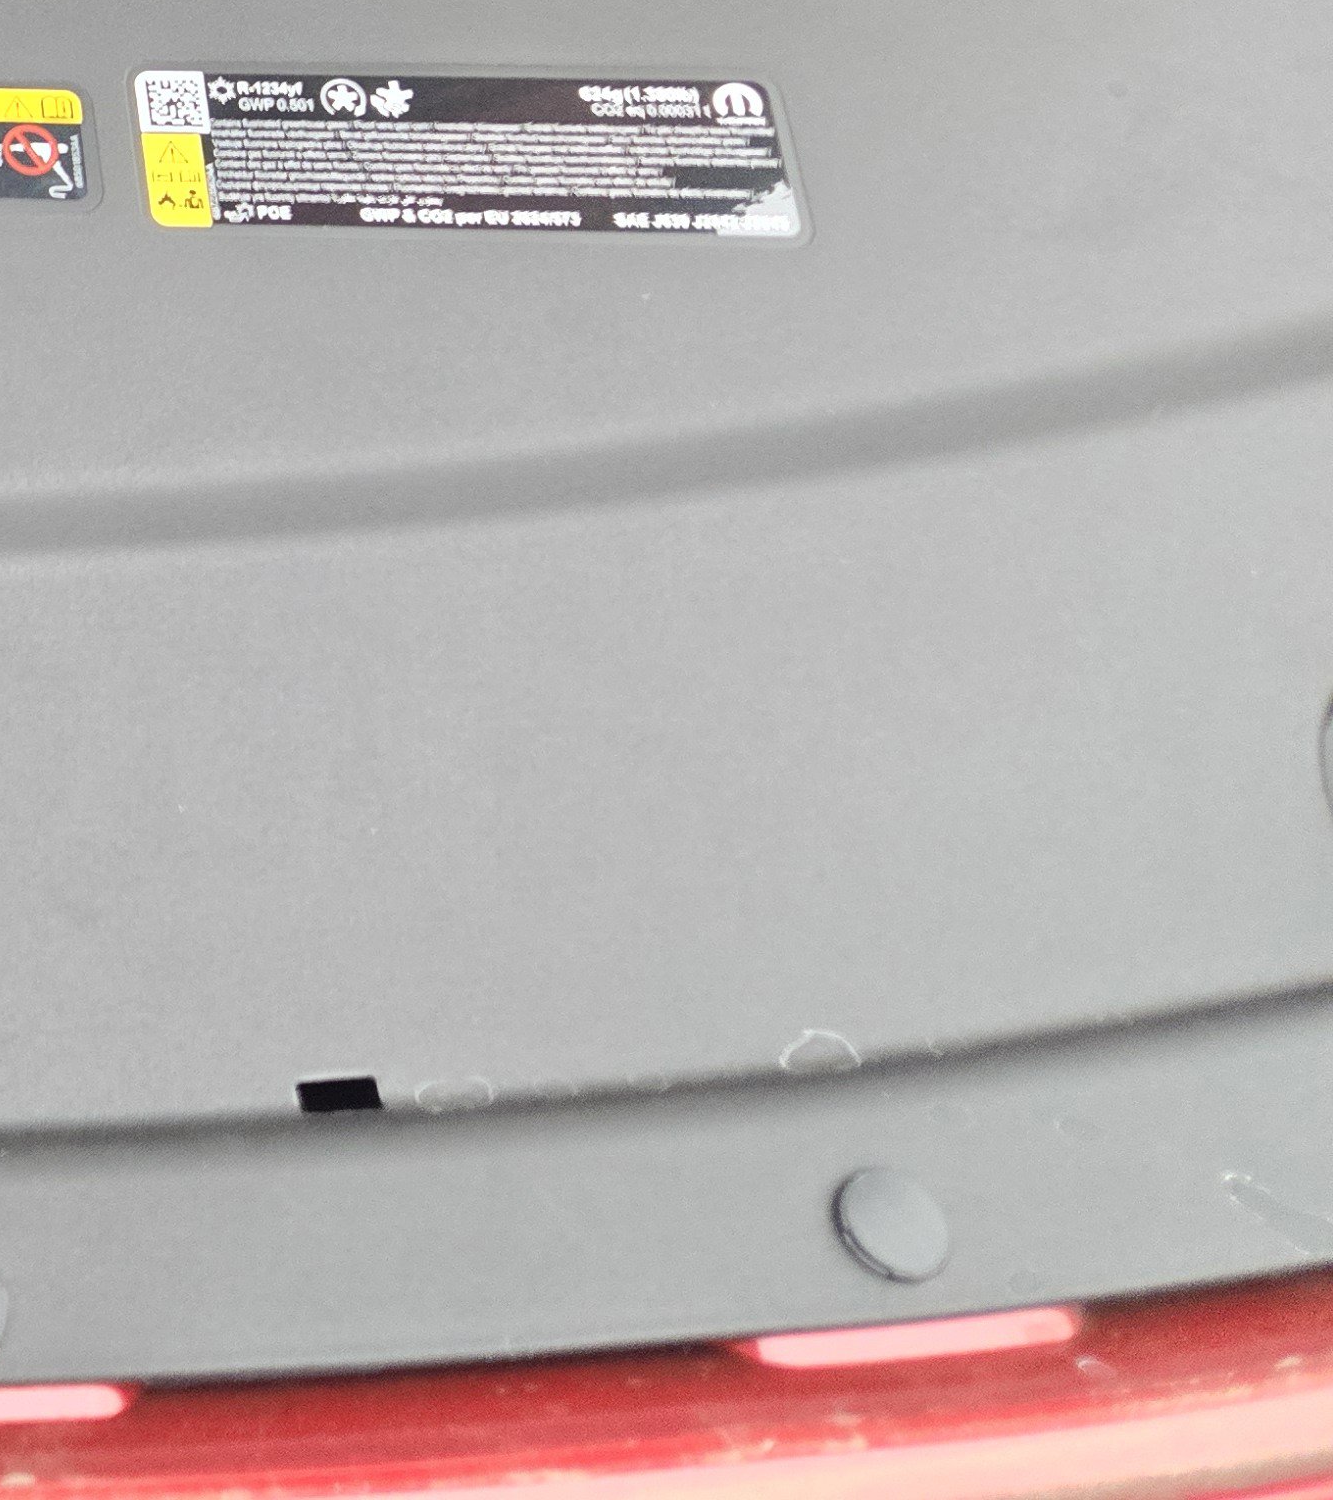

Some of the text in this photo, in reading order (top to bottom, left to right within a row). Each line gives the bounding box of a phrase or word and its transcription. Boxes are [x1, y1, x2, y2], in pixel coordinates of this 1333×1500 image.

[237, 81, 303, 97] R-1234yf
[238, 98, 275, 112] GWP
[591, 103, 623, 117] CO2
[256, 205, 292, 220] POE
[359, 207, 401, 223] GWP
[401, 208, 416, 223] &
[418, 209, 454, 224] CO2
[455, 212, 483, 226] per
[484, 210, 509, 225] EU
[614, 213, 649, 228] SAE
